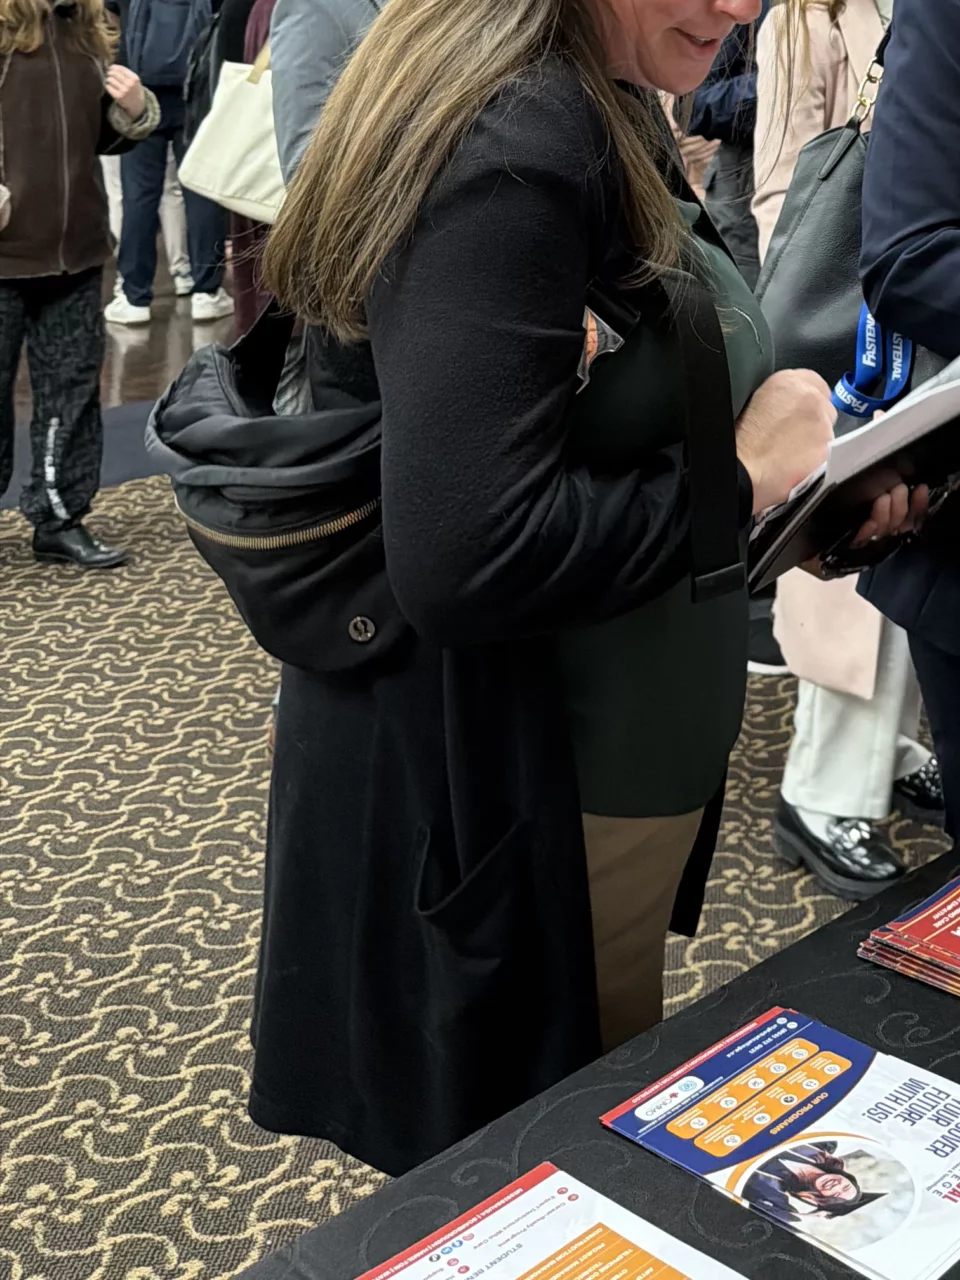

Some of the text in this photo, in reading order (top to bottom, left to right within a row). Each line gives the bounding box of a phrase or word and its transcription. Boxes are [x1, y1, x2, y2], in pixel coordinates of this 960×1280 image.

[766, 1090, 830, 1136] OUR PROGRAMS
[860, 1076, 930, 1124] WITH US!
[891, 1085, 952, 1127] FUTURE
[478, 1187, 525, 1217] MISSISSAUGA
[482, 1242, 525, 1270] STUDENT
[553, 1226, 604, 1261] CONSTRUCTION
